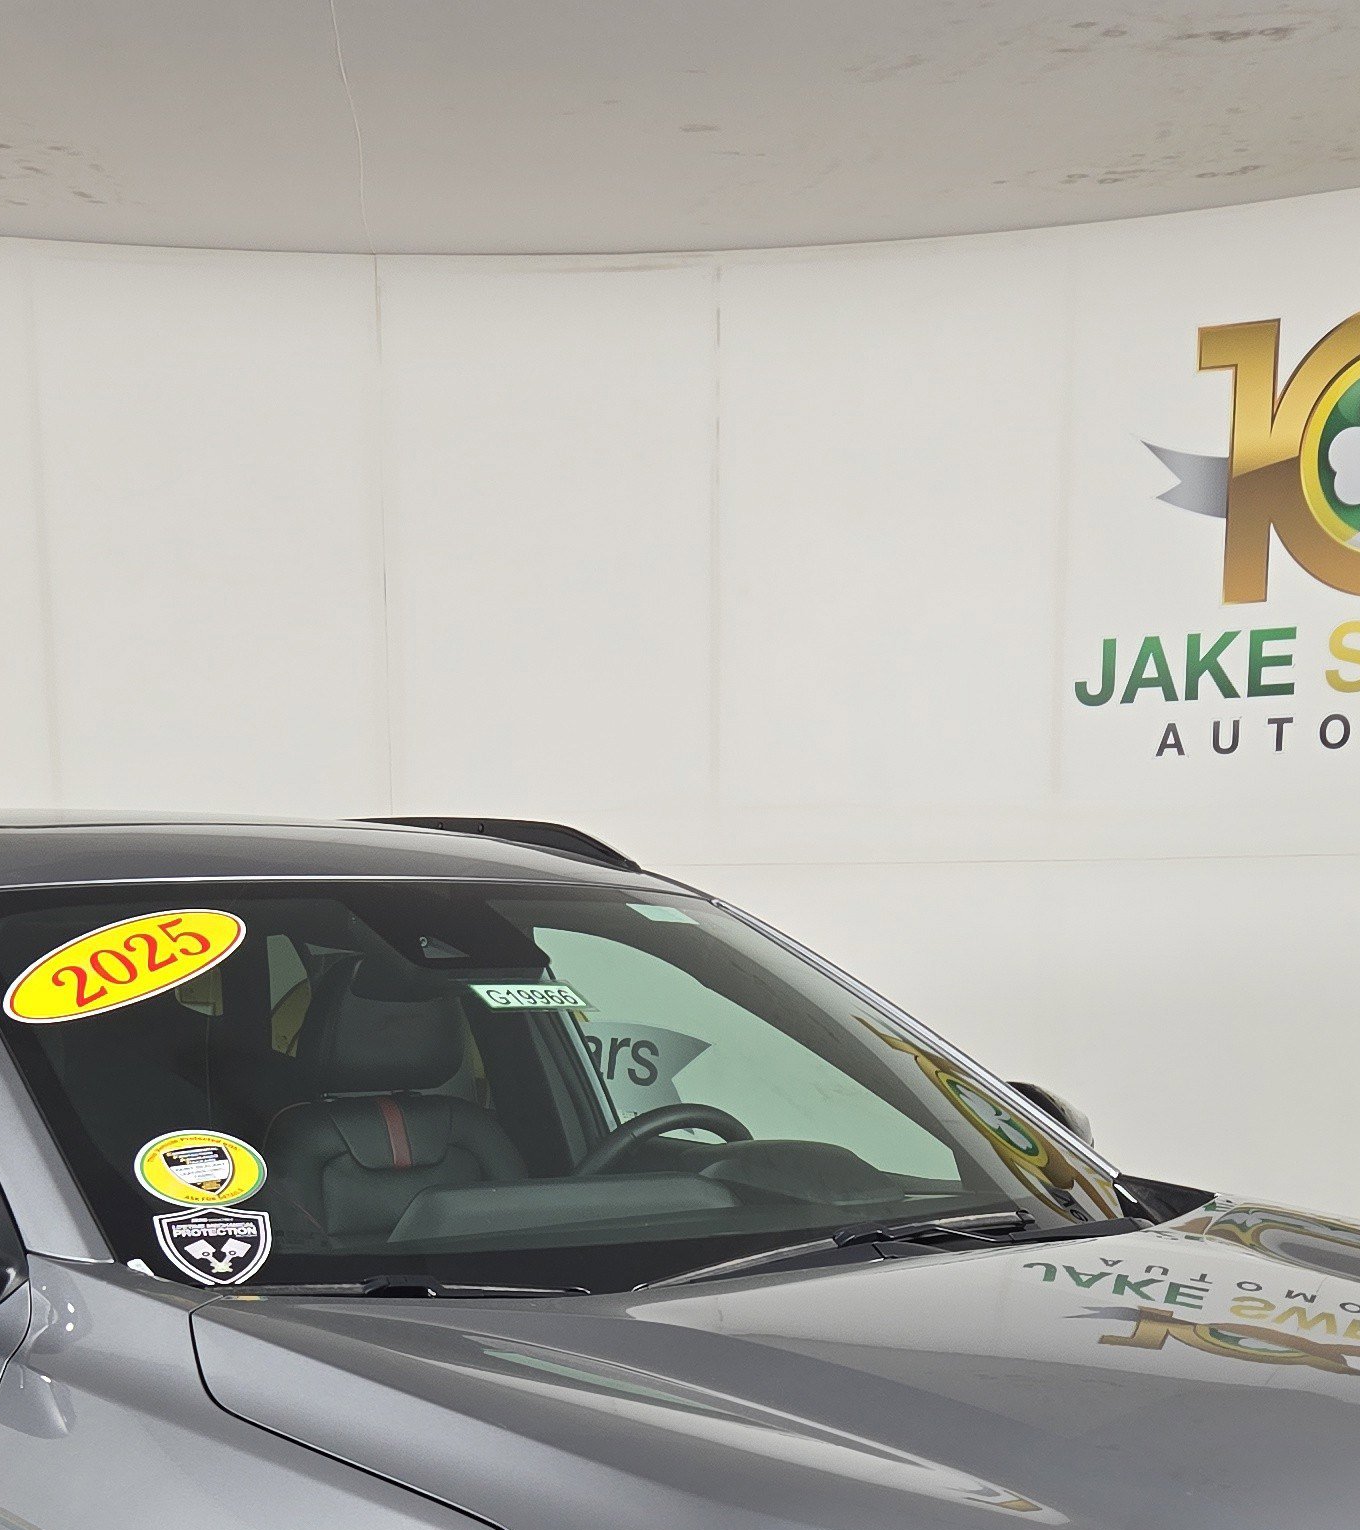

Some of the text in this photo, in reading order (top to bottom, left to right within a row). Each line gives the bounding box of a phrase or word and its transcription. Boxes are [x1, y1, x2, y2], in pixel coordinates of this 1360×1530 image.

[1073, 626, 1298, 706] JAKE
[51, 917, 211, 1008] 2025
[486, 989, 578, 1006] G19966
[173, 1227, 258, 1238] PROTECTION
